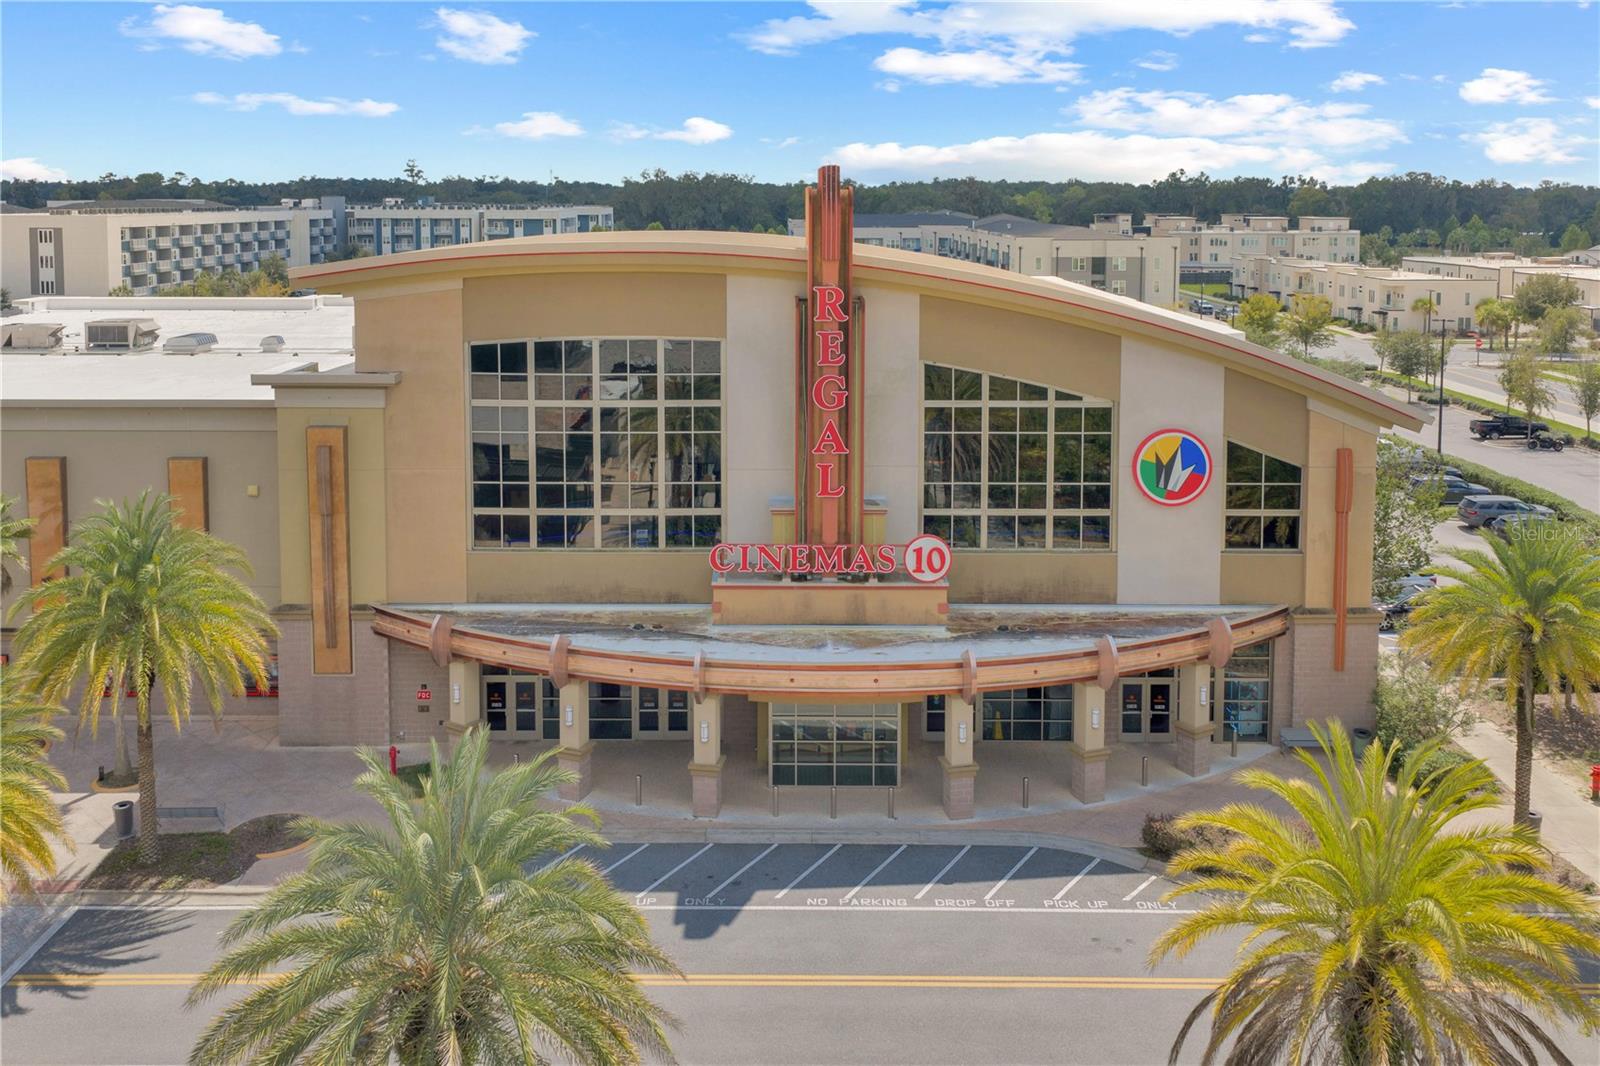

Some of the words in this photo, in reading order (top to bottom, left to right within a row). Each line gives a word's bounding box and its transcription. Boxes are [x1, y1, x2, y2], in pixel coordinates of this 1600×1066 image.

[812, 286, 849, 497] REGAL
[708, 543, 897, 574] CINEMAS
[911, 546, 946, 574] 10
[635, 897, 657, 907] UP
[683, 897, 728, 907] ONLY
[806, 897, 828, 907] NO
[838, 898, 908, 908] PARKING
[934, 898, 977, 908] DROP
[984, 898, 1015, 908] OFF
[1043, 899, 1080, 909] PICK
[1087, 900, 1108, 910] UP
[1135, 900, 1177, 910] ONLY
